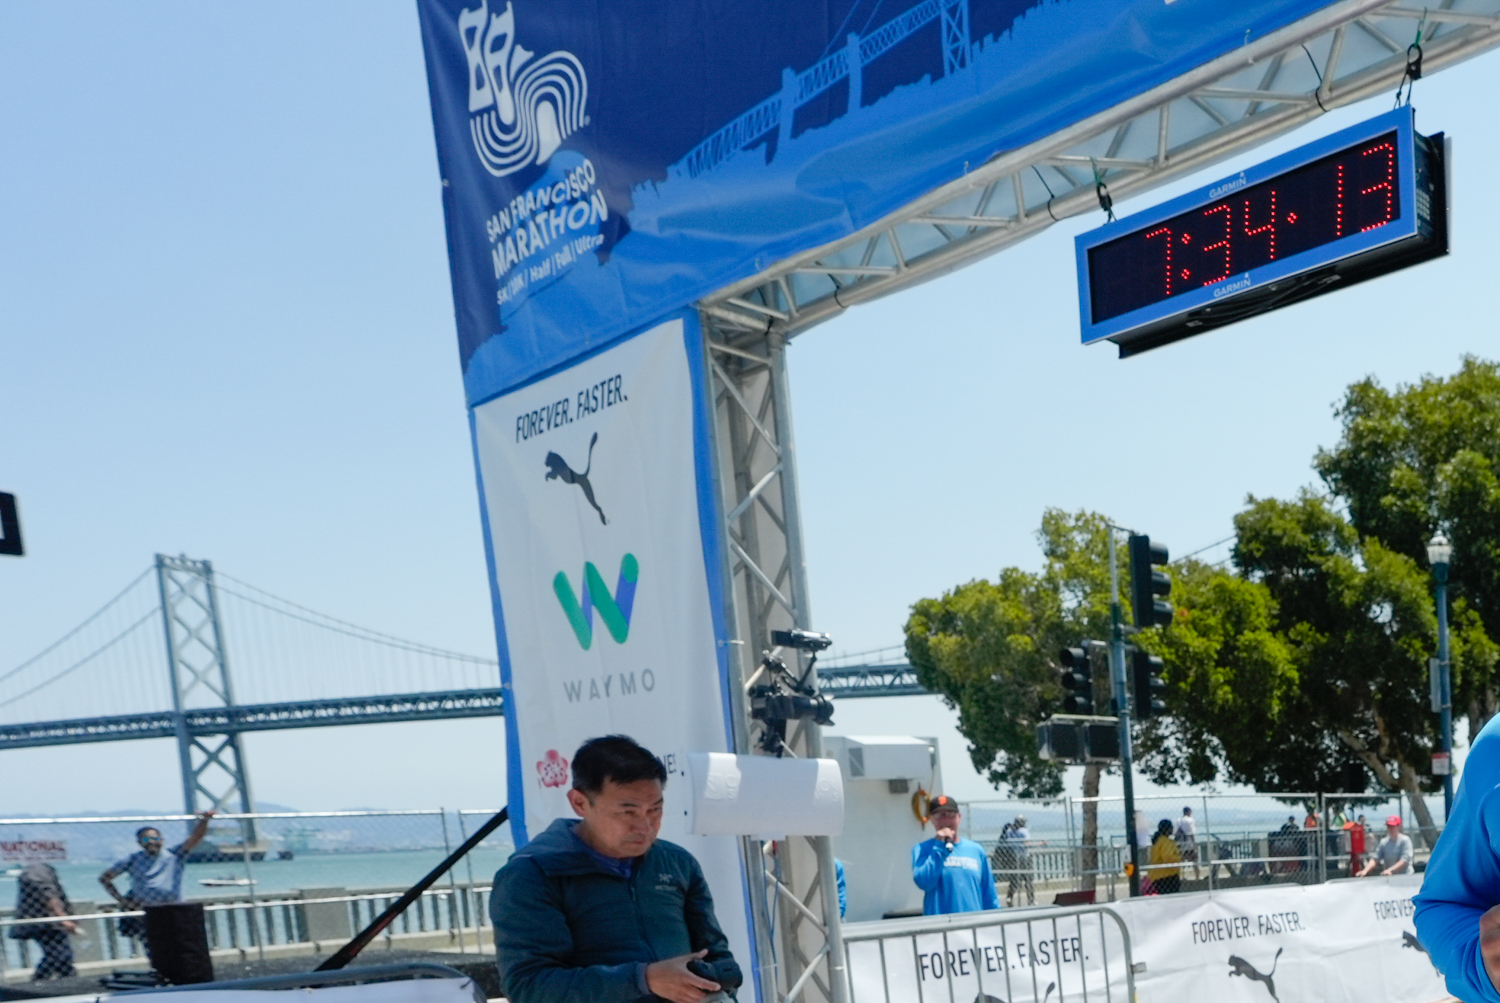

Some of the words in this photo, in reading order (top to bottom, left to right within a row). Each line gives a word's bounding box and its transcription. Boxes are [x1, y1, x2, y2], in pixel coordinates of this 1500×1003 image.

[486, 208, 511, 243] SAN
[509, 158, 596, 220] FRANCISCO
[1209, 176, 1247, 199] GARMIN
[491, 189, 608, 280] MARATHON
[1213, 277, 1252, 298] GARMIN
[515, 399, 574, 444] FOREVER.
[576, 374, 629, 421] FASTER.
[563, 668, 656, 703] WAYMO
[1192, 916, 1255, 944] FOREVER.
[1258, 912, 1306, 936] FASTER.
